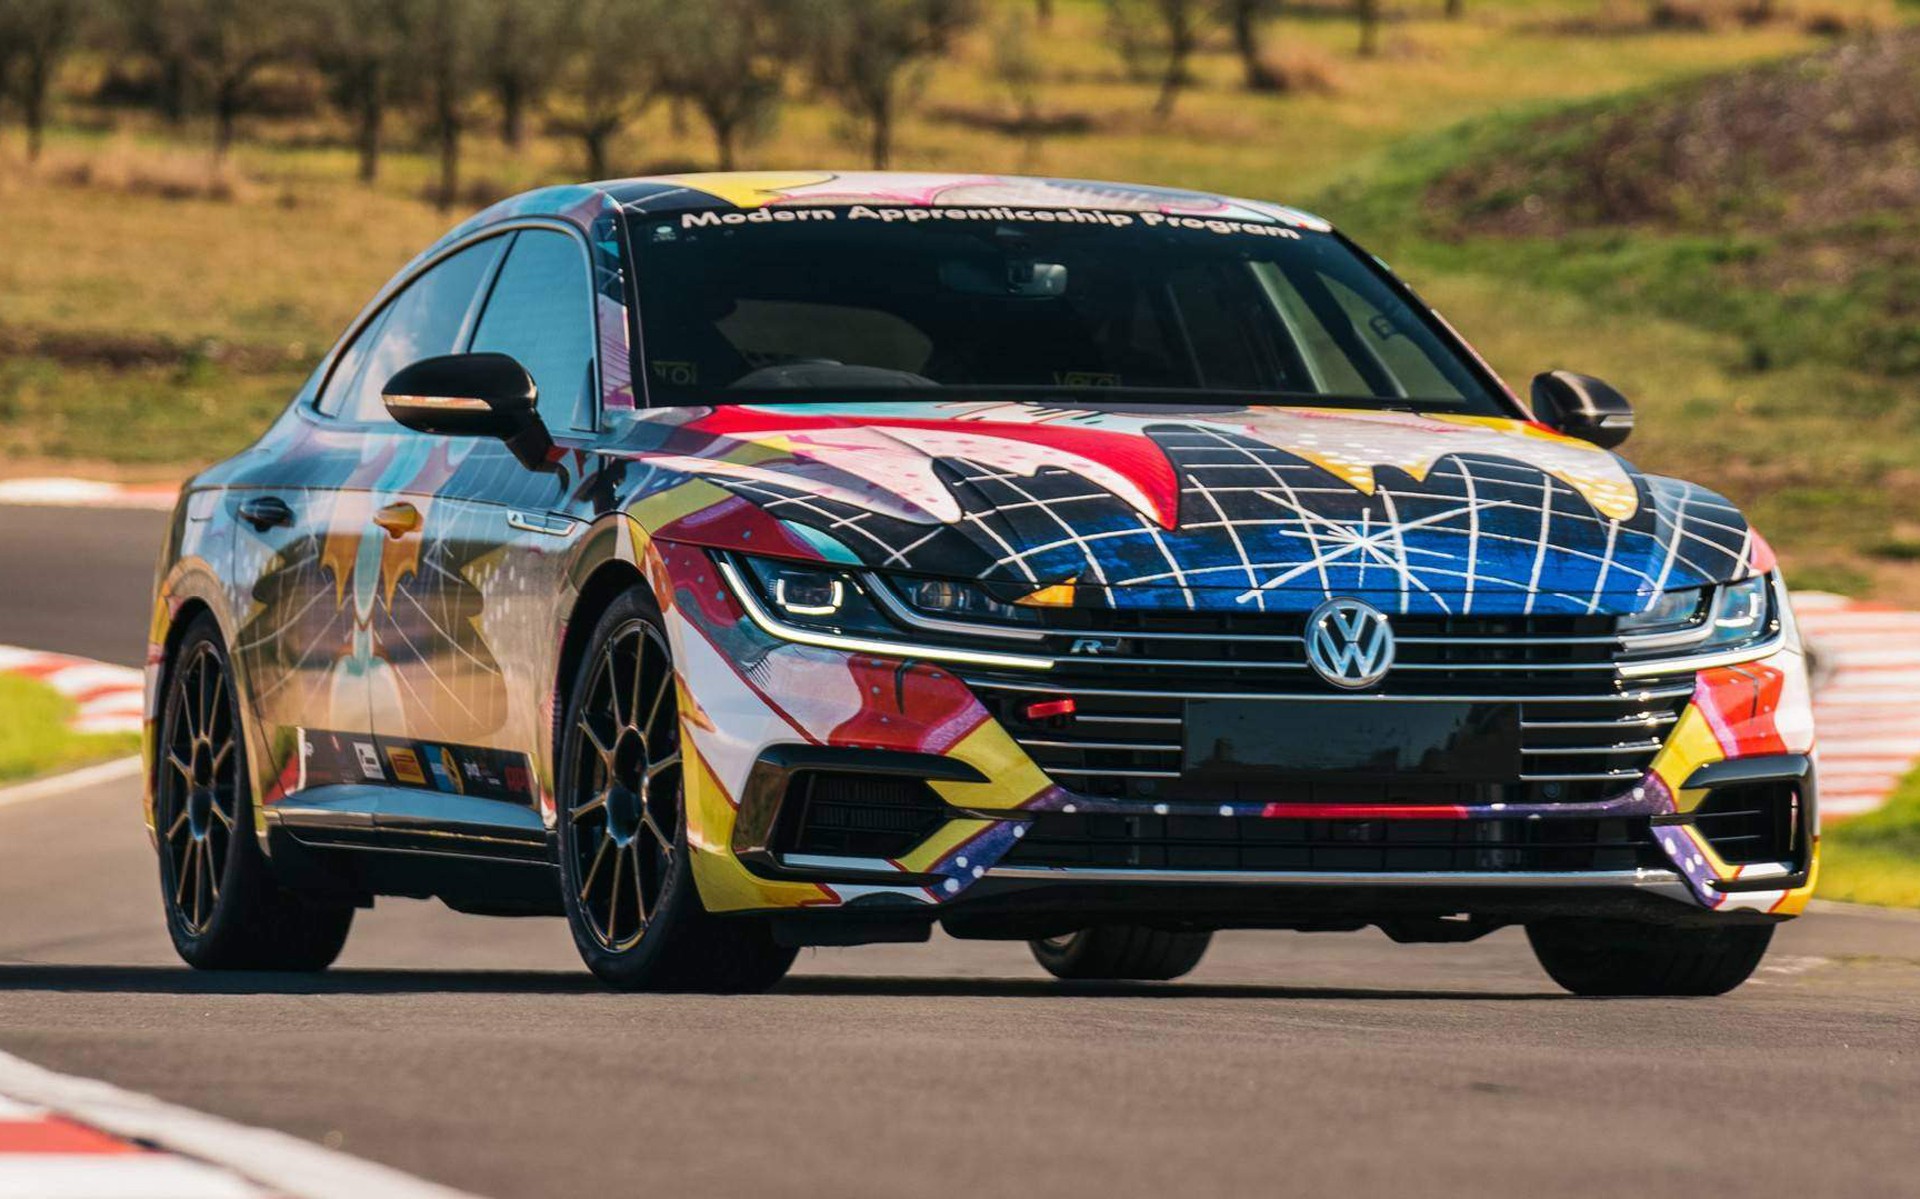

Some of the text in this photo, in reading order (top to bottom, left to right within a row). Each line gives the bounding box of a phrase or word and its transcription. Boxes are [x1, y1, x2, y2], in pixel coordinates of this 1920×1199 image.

[681, 205, 1302, 241] Modern Apprenticeship Program
[1309, 601, 1391, 684] VW
